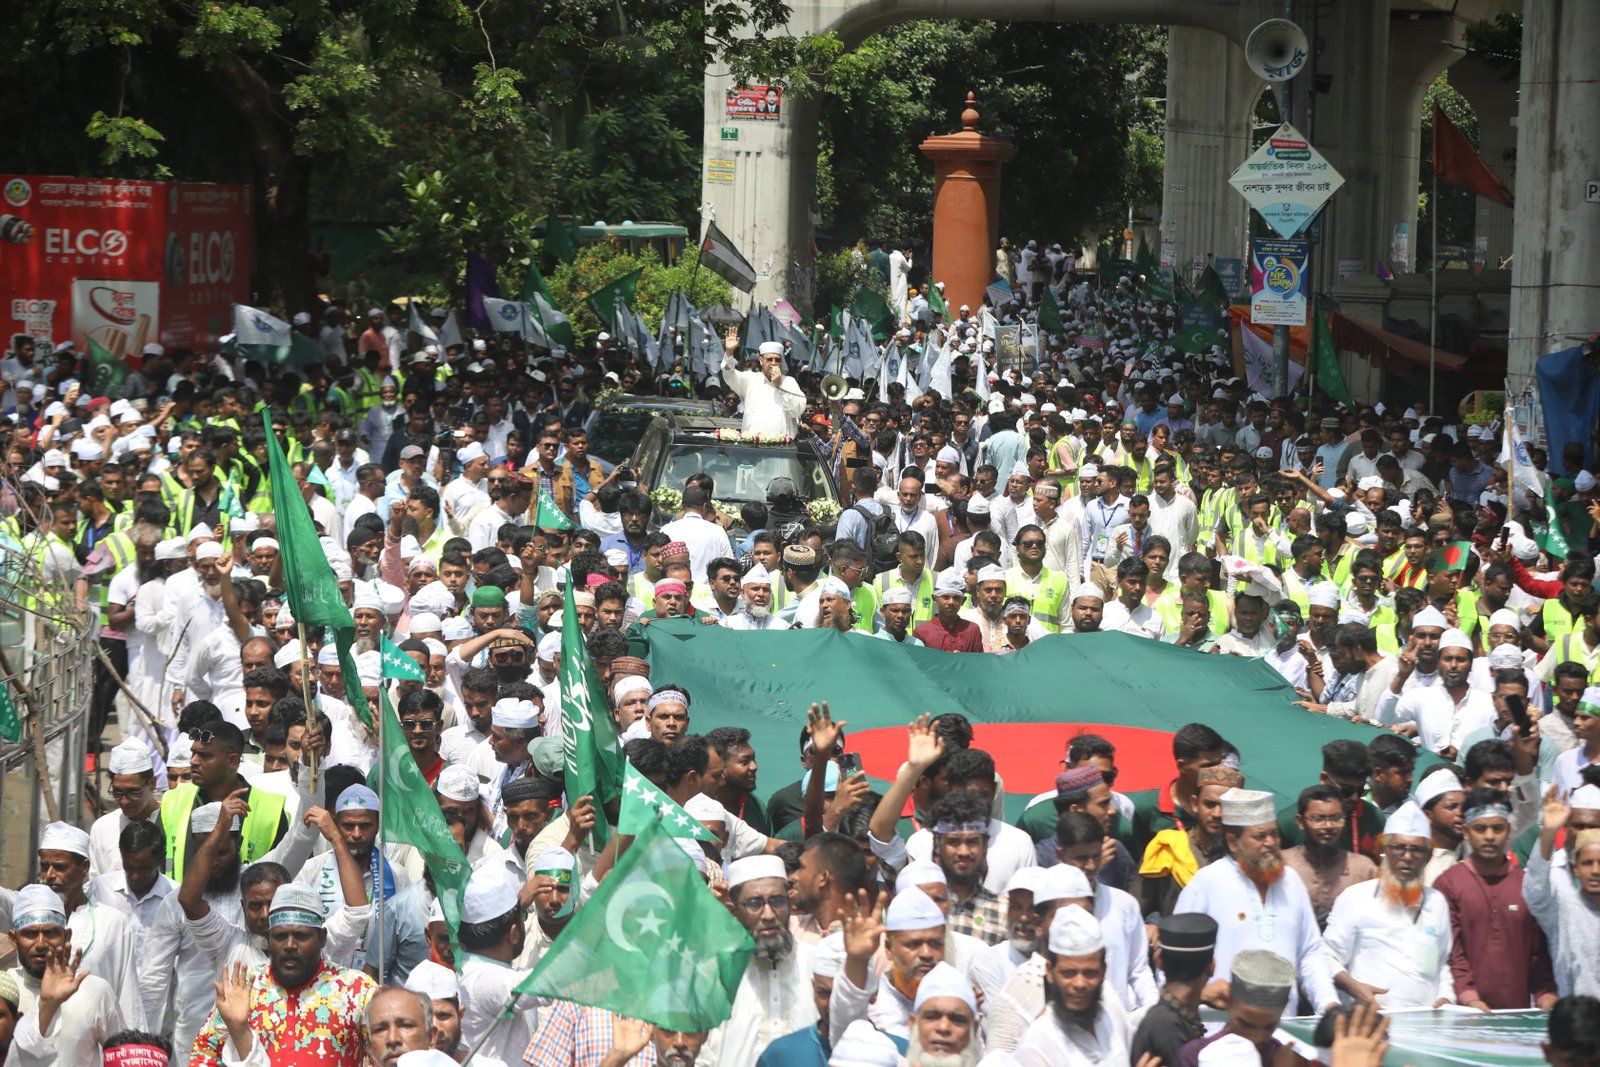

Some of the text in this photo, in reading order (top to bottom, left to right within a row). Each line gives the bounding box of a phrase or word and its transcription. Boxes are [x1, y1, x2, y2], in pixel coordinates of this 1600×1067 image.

[1286, 161, 1304, 170] দিবস
[1306, 162, 1328, 171] ২০২৫
[1243, 181, 1331, 193] নেশামুক্ত সুন্দর জীবন চাই
[1589, 184, 1600, 199] P
[45, 228, 128, 256] ELCO
[45, 256, 124, 265] cables
[190, 231, 235, 284] ELCO
